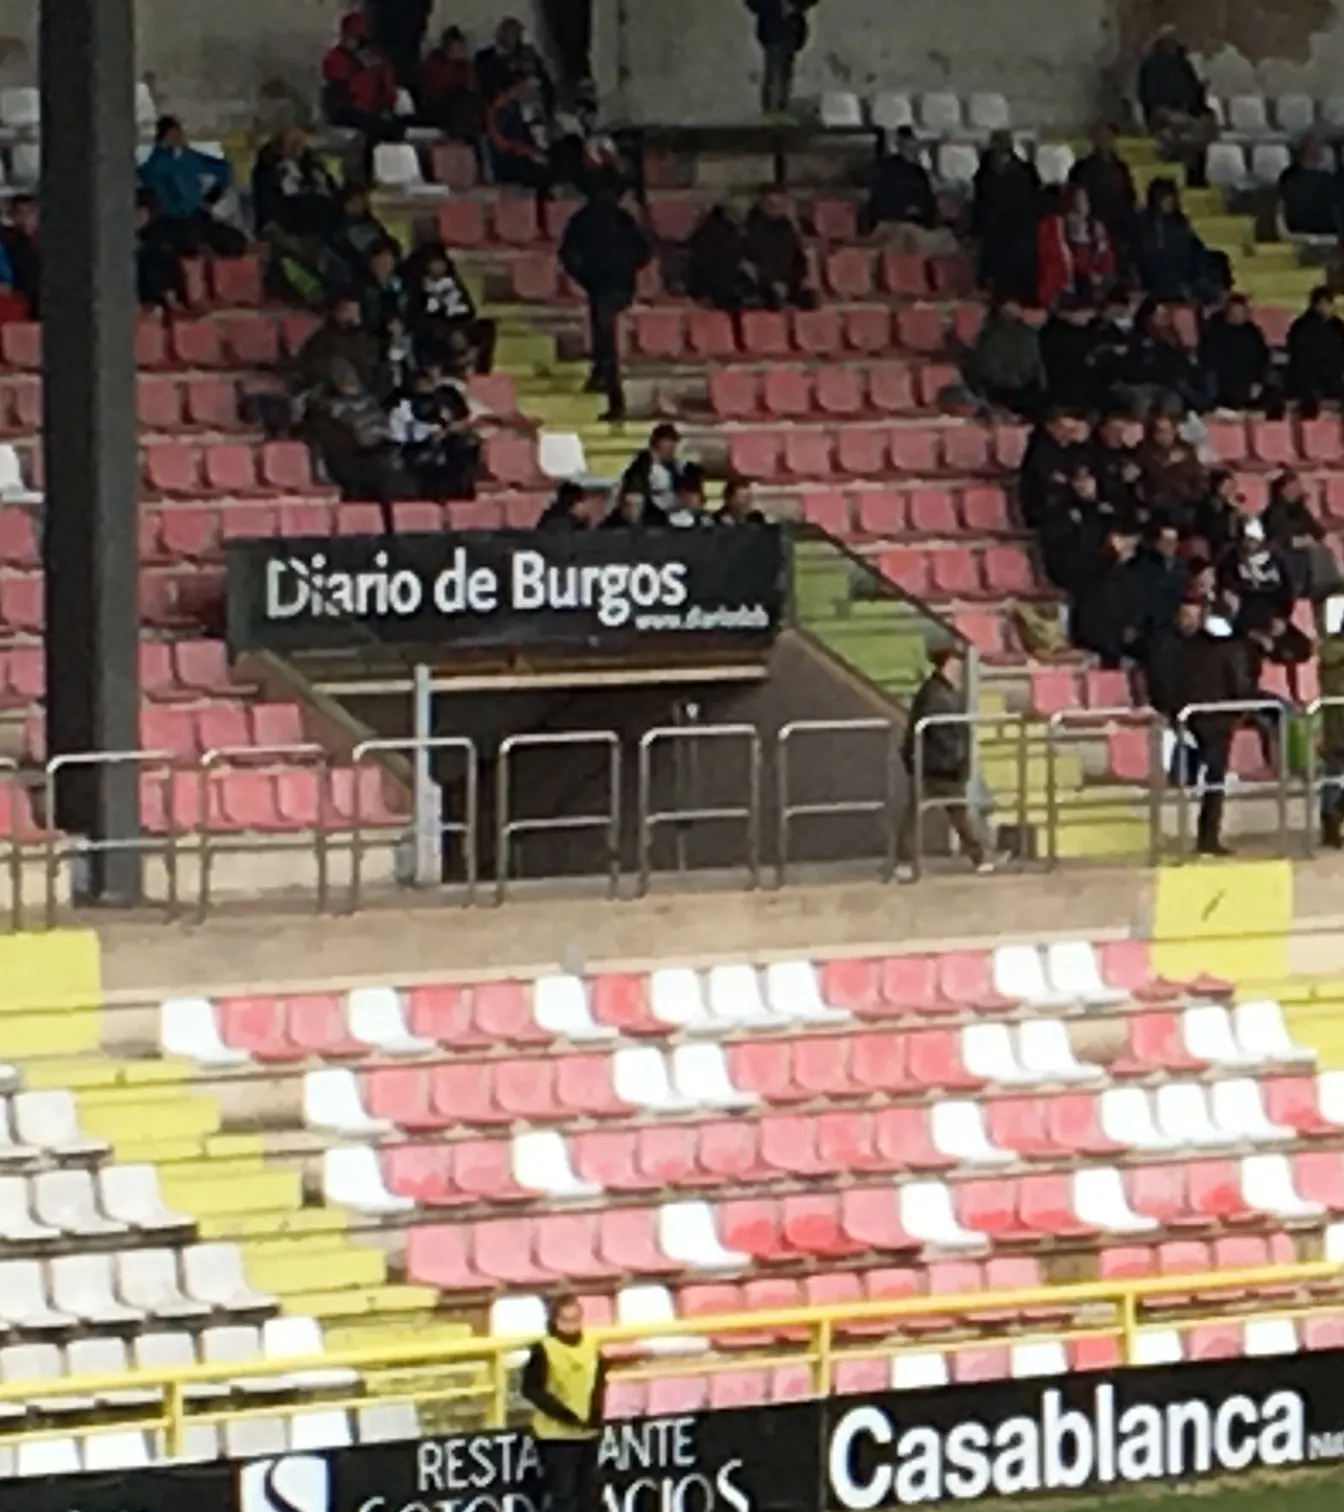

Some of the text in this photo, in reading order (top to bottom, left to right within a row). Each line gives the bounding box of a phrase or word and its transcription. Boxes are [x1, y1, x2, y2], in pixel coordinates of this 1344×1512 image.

[265, 546, 688, 627] Diario de Burgos
[416, 1418, 696, 1492] RESTAANTE
[828, 1384, 1307, 1512] Casablanca
